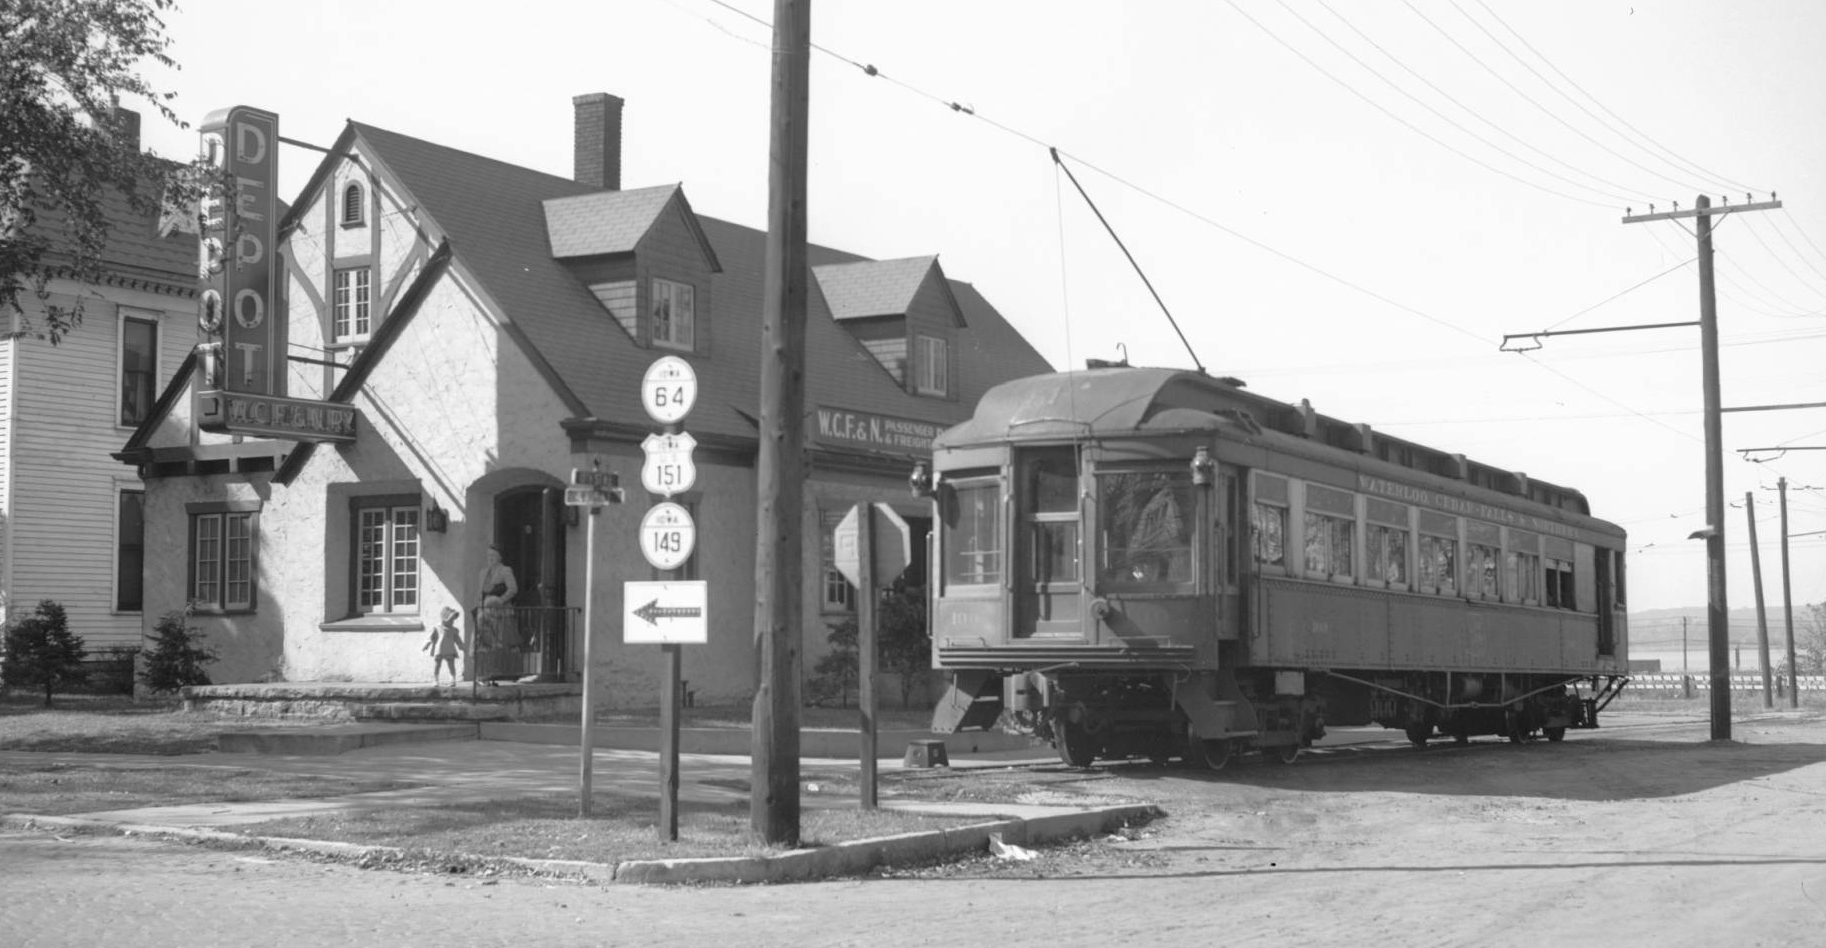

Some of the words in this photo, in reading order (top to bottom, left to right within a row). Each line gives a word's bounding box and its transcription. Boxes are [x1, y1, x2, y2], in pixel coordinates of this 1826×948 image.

[235, 121, 266, 387] DEPOT
[655, 386, 684, 407] 64
[657, 464, 682, 486] 151
[656, 514, 679, 524] IOWA
[654, 531, 681, 552] 149
